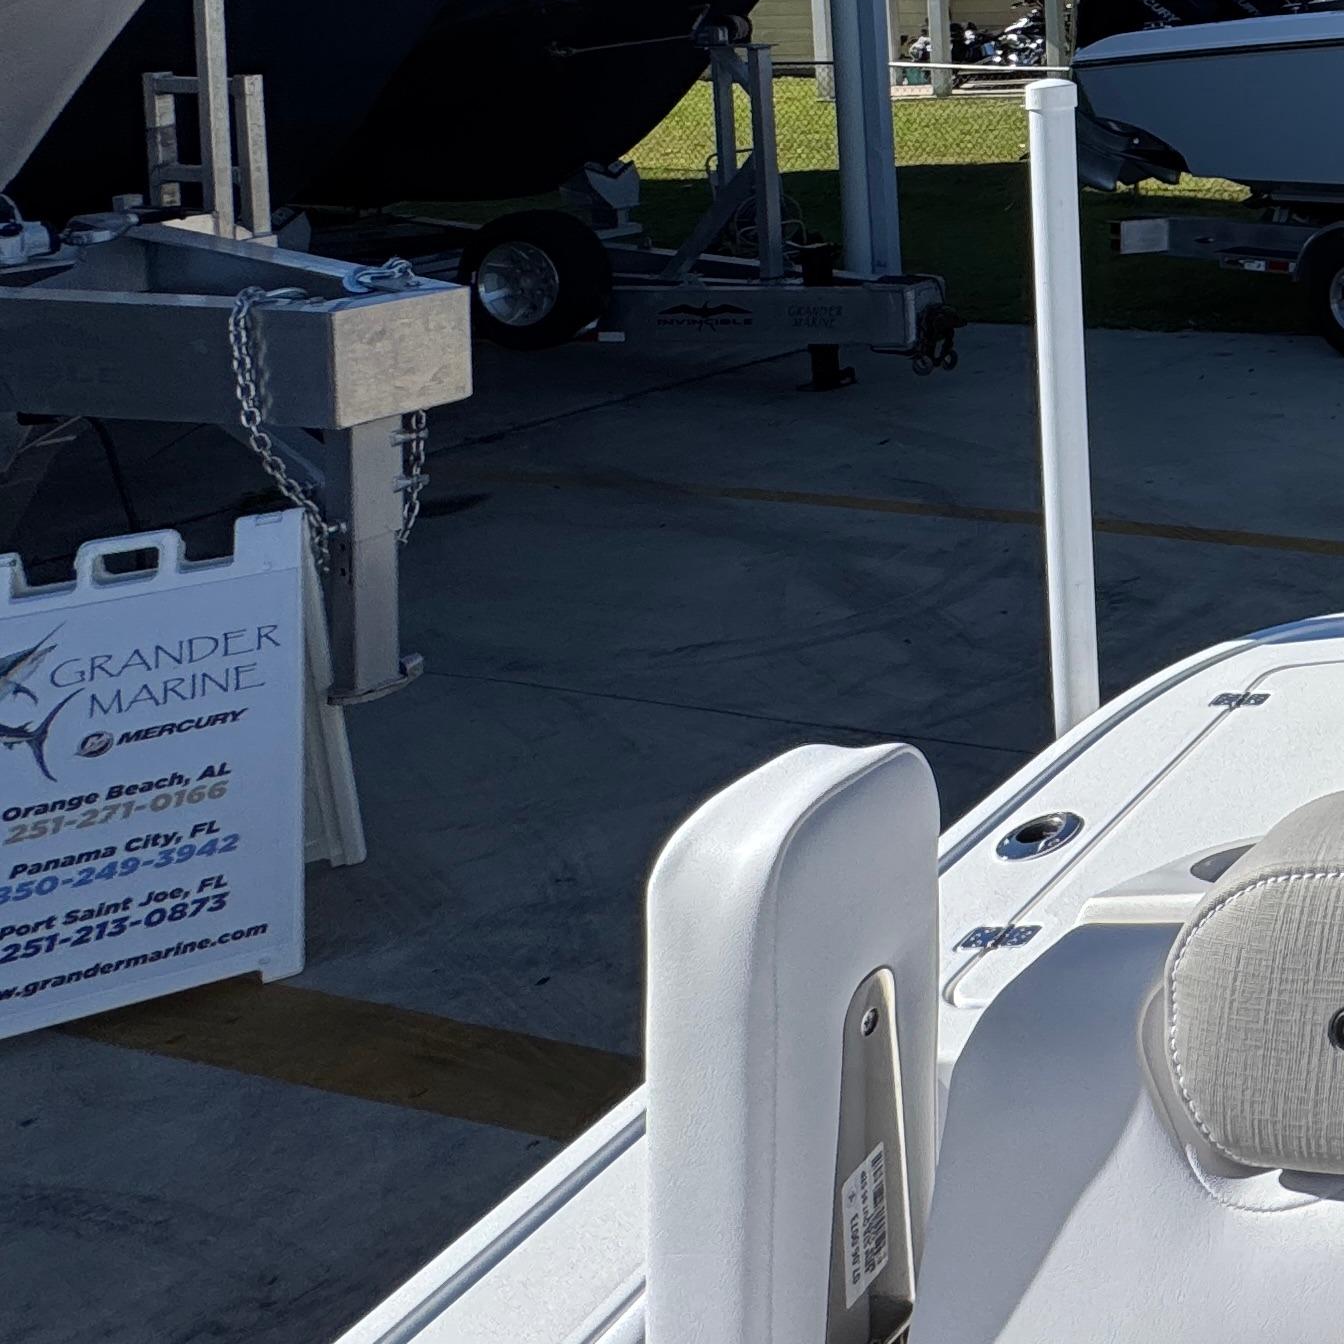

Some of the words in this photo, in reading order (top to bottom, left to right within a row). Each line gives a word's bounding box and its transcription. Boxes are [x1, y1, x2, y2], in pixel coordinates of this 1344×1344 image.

[50, 624, 281, 688] GRANDER
[89, 662, 266, 719] MARINE
[116, 707, 249, 746] MERCURY
[2, 791, 100, 823] Orange
[105, 771, 190, 801] Beach,
[196, 762, 232, 781] AL
[4, 780, 229, 845] 251-271-0166
[9, 846, 117, 880] Panama
[125, 830, 183, 853] City,
[190, 820, 220, 838] FL
[0, 914, 58, 941] Port
[62, 896, 134, 926] Saint
[138, 884, 190, 909] Joe,
[197, 874, 229, 895] FL
[0, 892, 231, 964] 251-213-0873
